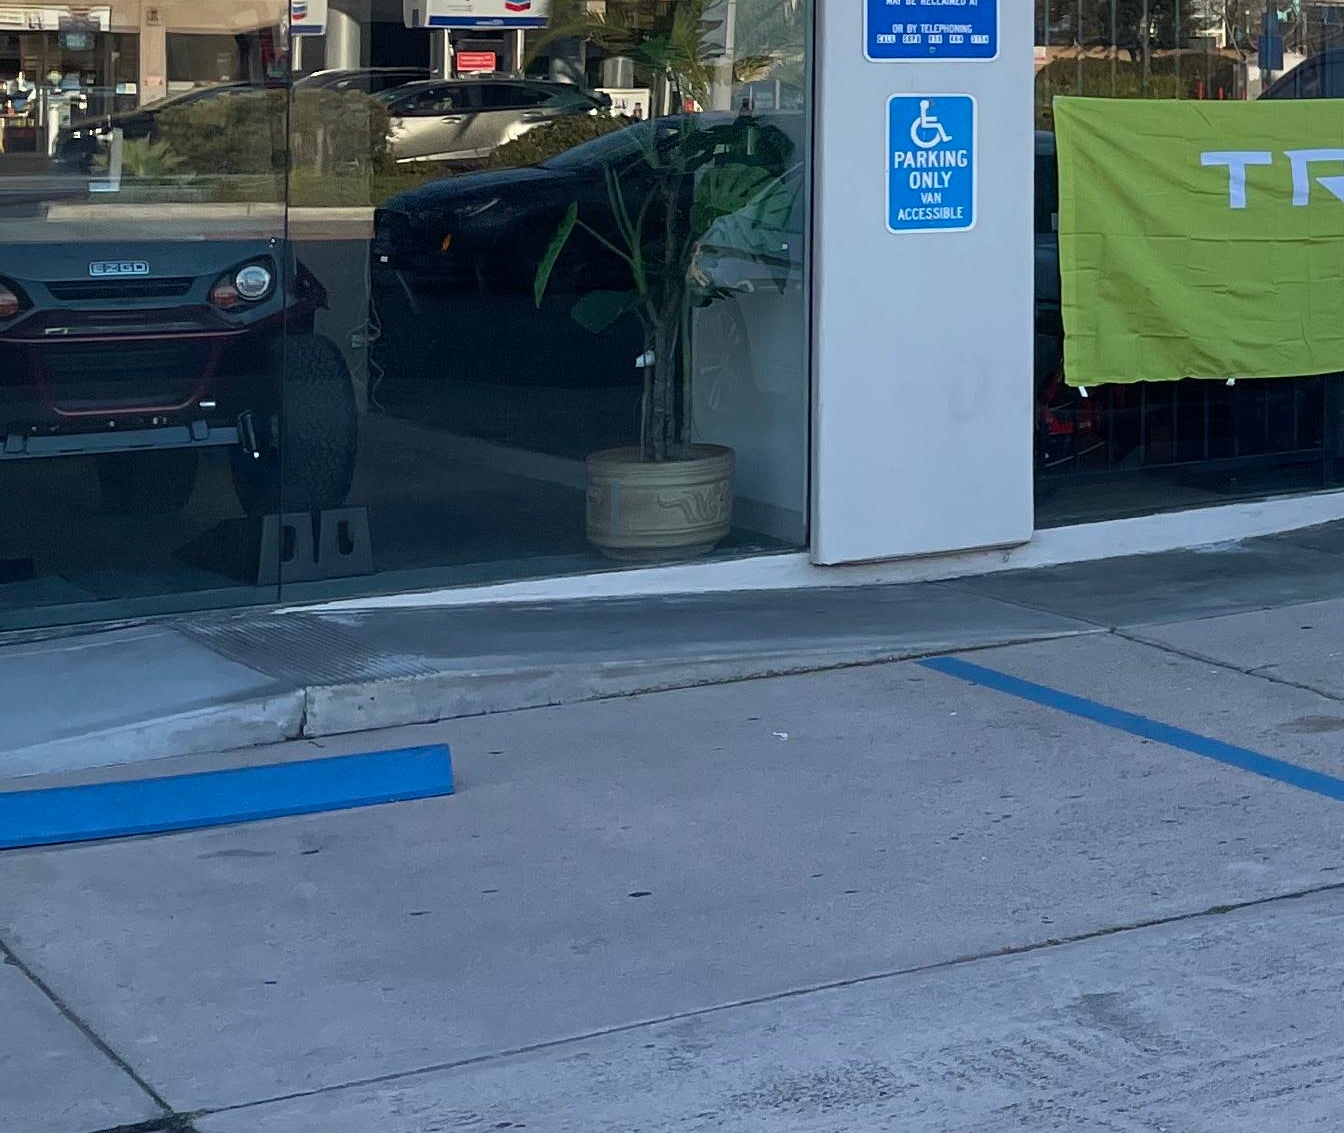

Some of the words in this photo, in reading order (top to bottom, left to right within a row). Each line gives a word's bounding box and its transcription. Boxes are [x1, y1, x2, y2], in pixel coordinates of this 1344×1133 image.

[892, 24, 903, 34] OR
[907, 24, 918, 34] BY
[921, 24, 972, 34] TELEPHONING
[894, 150, 968, 169] PARKING
[909, 171, 952, 189] ONLY
[920, 193, 942, 204] VAN
[898, 207, 964, 221] ACCESSIBLE
